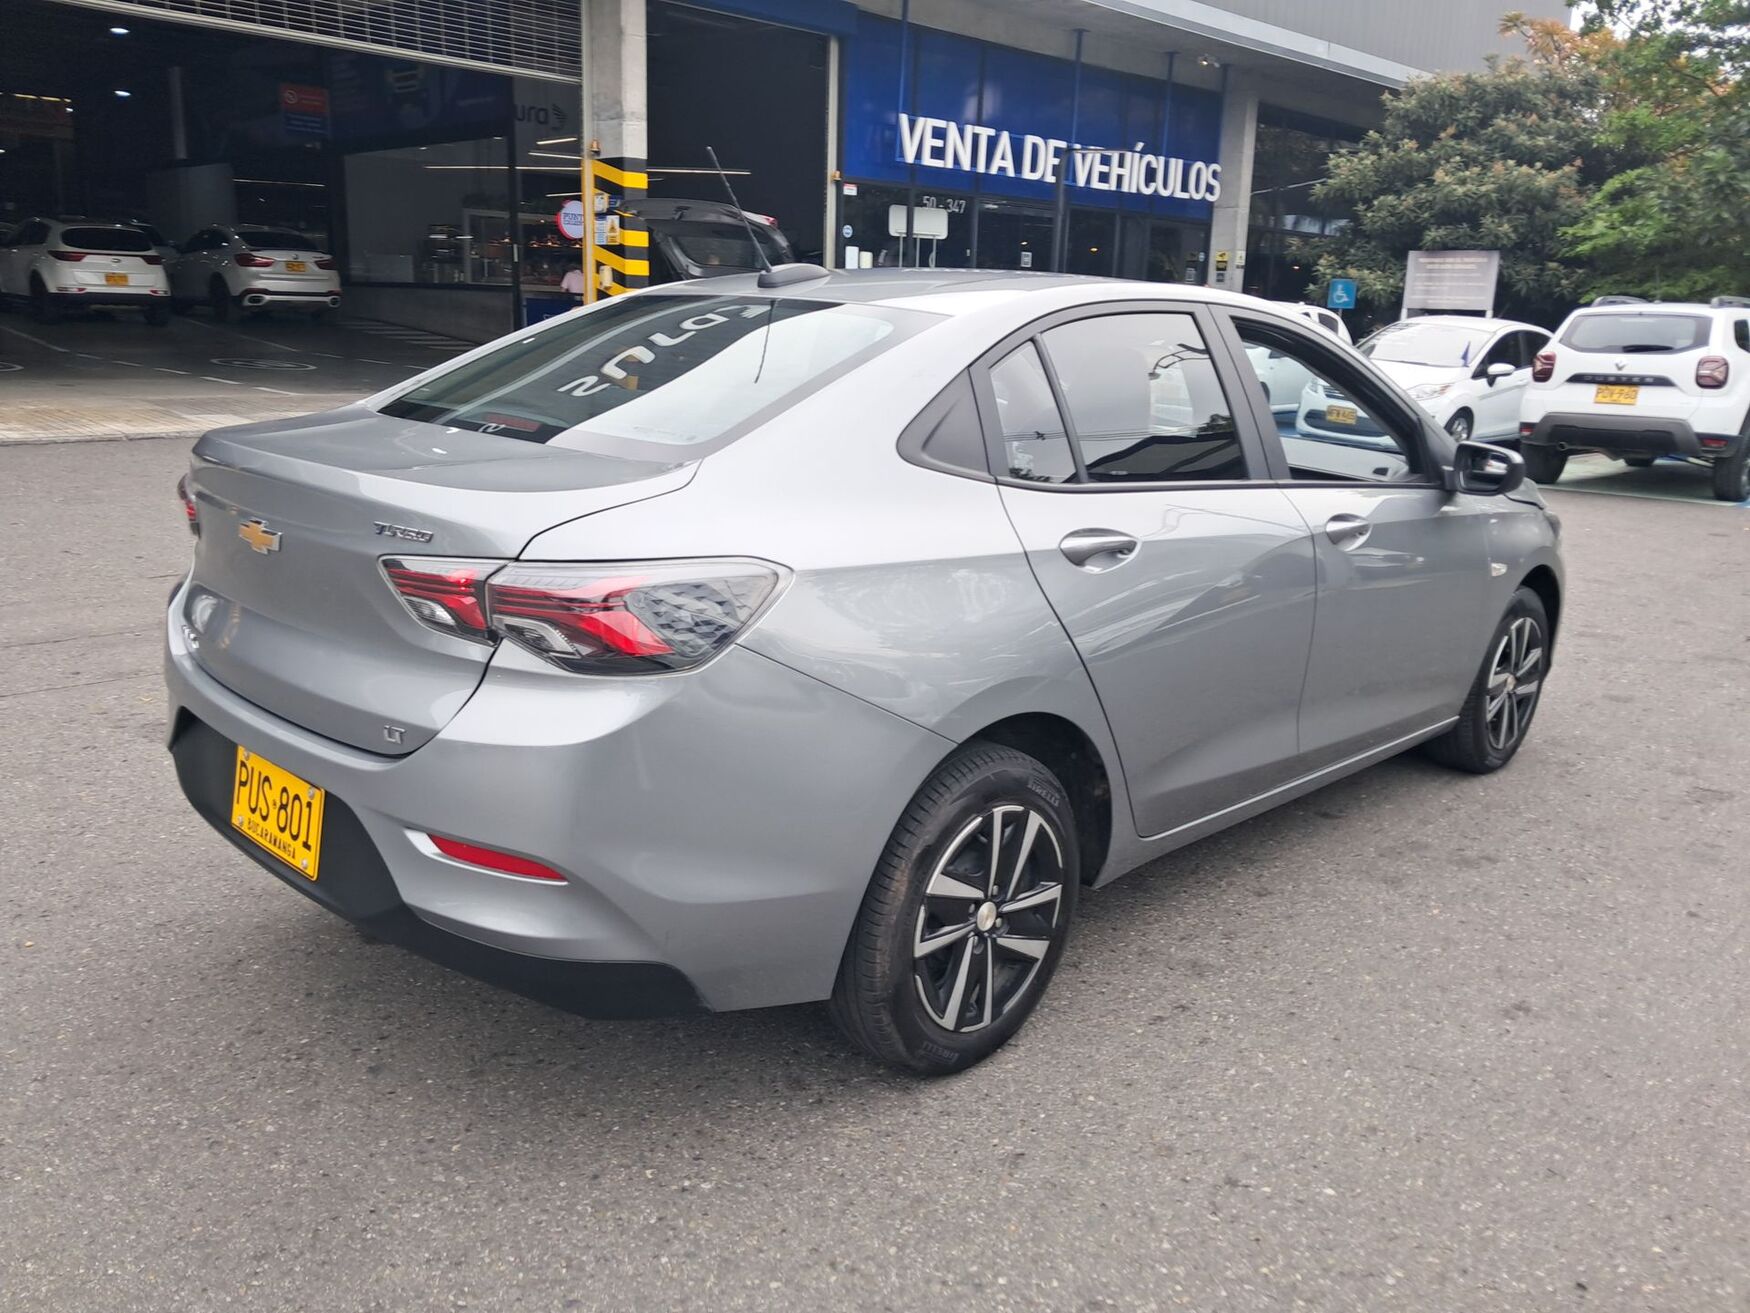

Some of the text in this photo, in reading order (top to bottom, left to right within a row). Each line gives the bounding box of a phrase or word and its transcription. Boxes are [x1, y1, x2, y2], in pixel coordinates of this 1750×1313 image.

[514, 104, 549, 125] ura
[899, 113, 1222, 202] VENTA DE VEHÍCULOS
[946, 199, 966, 214] 347
[383, 724, 406, 745] LT
